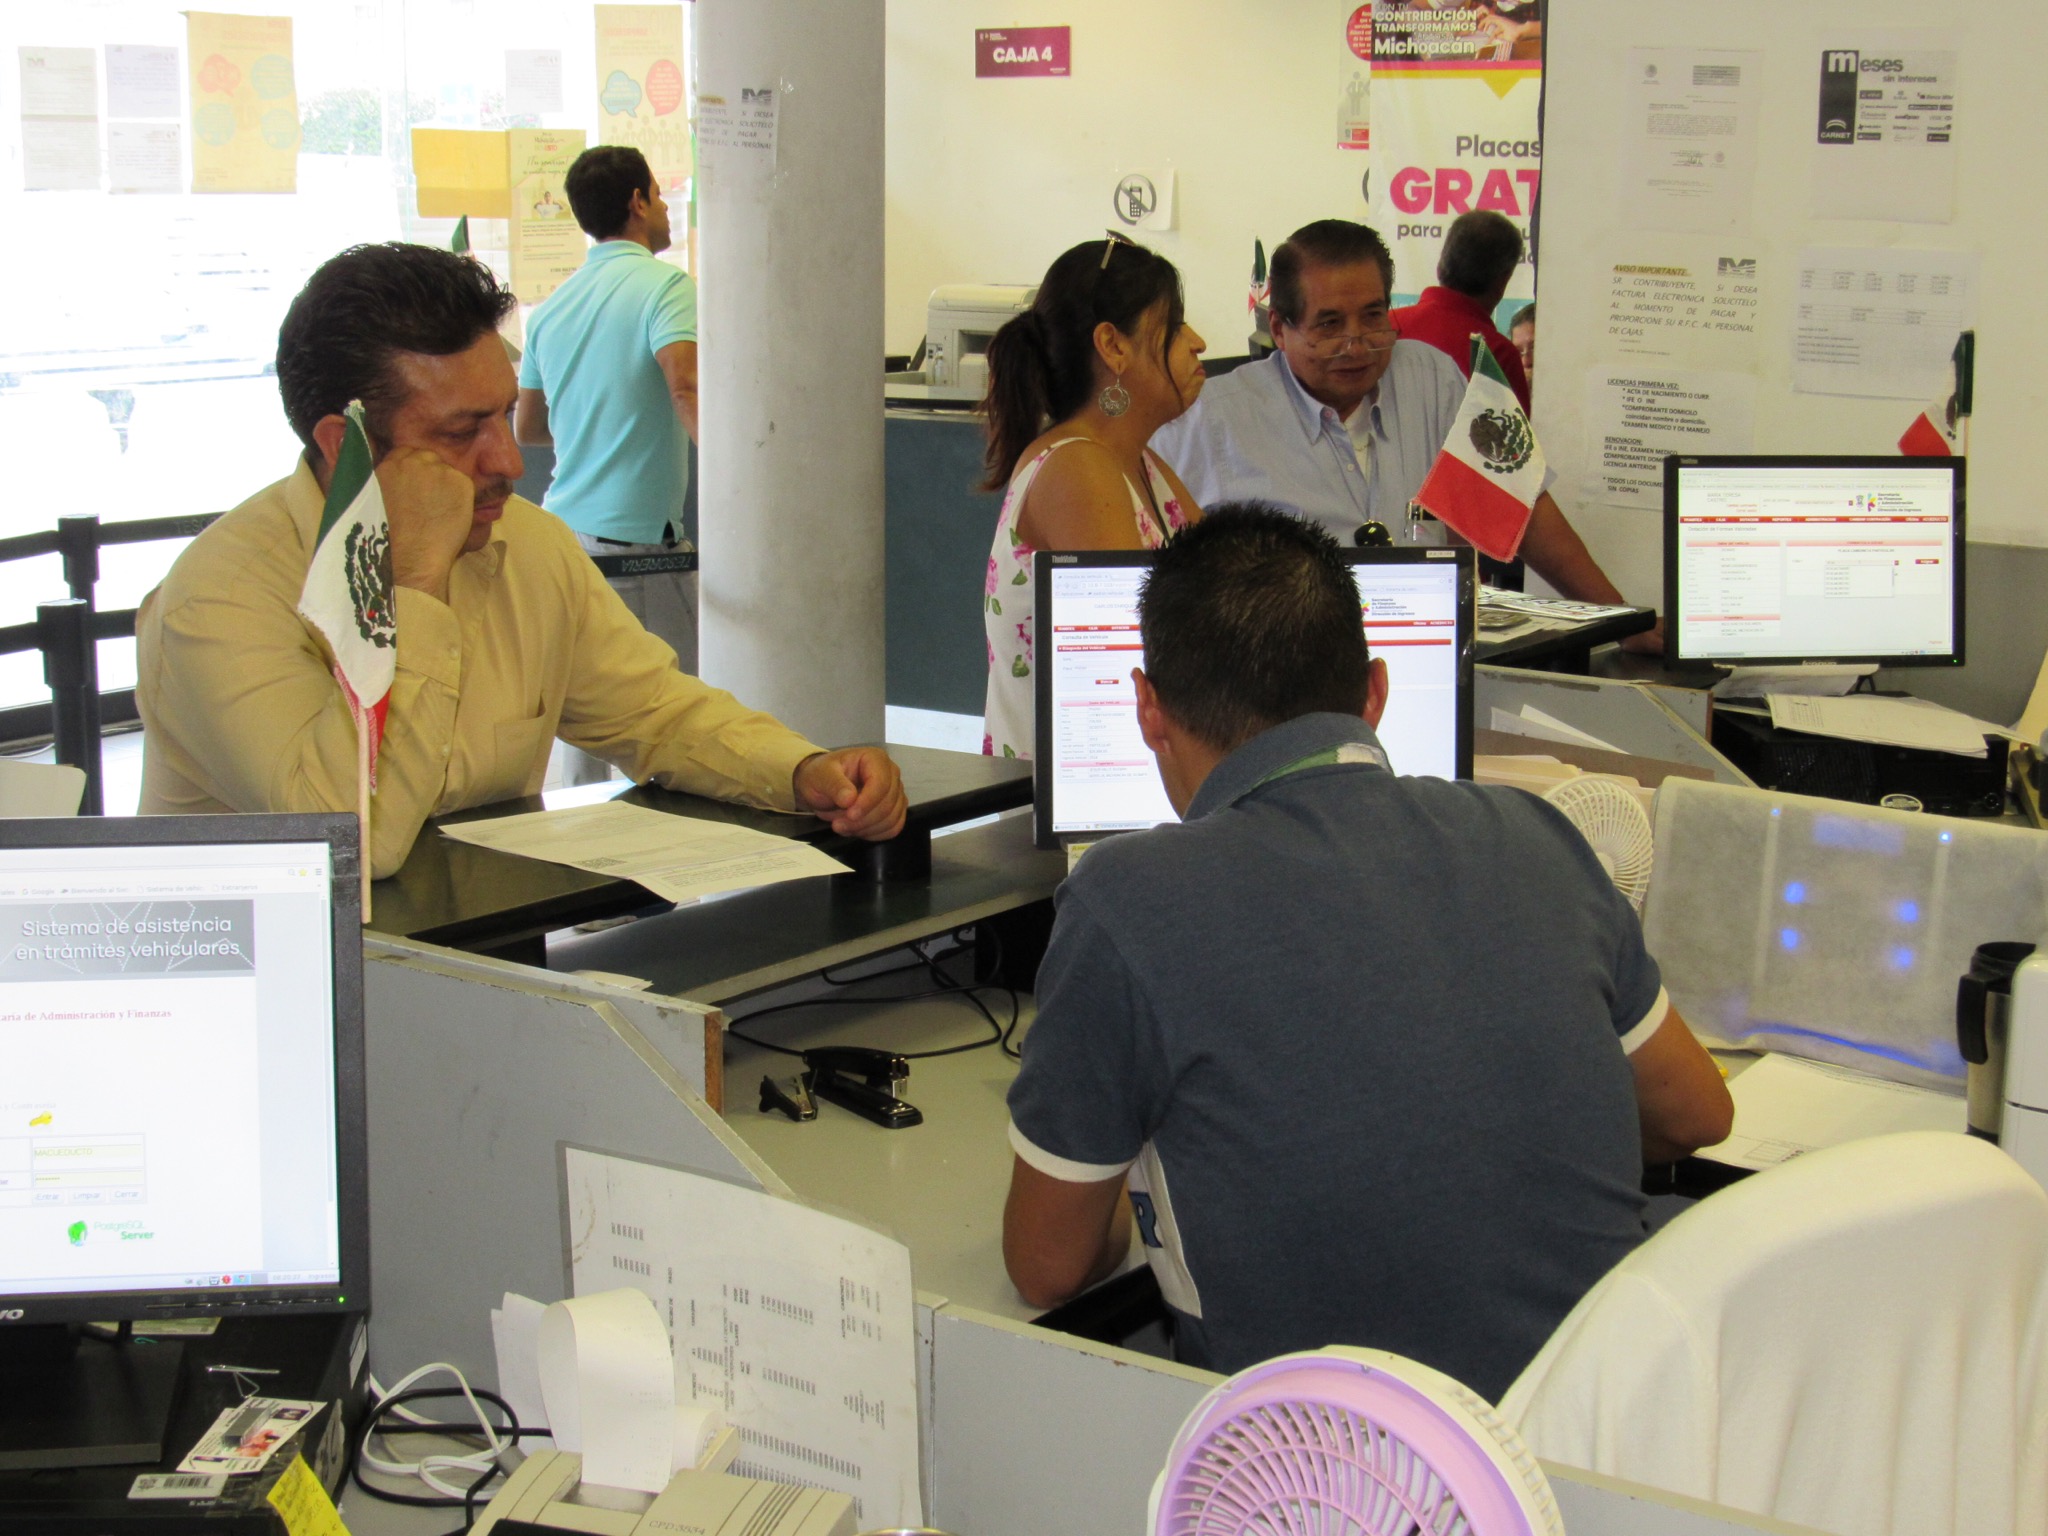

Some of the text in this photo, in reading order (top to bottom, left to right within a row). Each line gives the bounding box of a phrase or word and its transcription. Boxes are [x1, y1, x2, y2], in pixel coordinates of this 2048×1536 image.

[1375, 7, 1477, 22] CONTRIBUCIÓN
[1375, 22, 1477, 33] TRANSFORMAMOS
[1374, 36, 1475, 55] Michoacán
[993, 46, 1053, 63] CAJA 4
[1882, 75, 1937, 83] sin intereses
[1820, 132, 1852, 140] CARNET
[1456, 135, 1542, 158] Placas
[1397, 223, 1442, 241] para
[1613, 265, 1637, 273] AVISO
[1611, 289, 1646, 299] FACTURA
[1653, 292, 1705, 303] ELECTRONICA
[1733, 285, 1758, 294] DESEA
[1633, 303, 1674, 314] MOMENTO
[1686, 307, 1698, 315] DE
[1710, 309, 1737, 318] PAGAR
[1609, 314, 1663, 325] PROPORCIONE
[1715, 322, 1755, 332] PERSONAL
[1607, 379, 1636, 387] LICENCIAS
[1638, 380, 1665, 389] PRIMERA
[1651, 390, 1687, 398] NACIMIENTO
[1686, 426, 1711, 434] MANEJO
[22, 916, 232, 937] Sistema de asistencia
[16, 940, 240, 960] en trámites vehiculares
[0, 1009, 172, 1021] aría de Administración y Finanzas
[121, 1231, 155, 1241] Server
